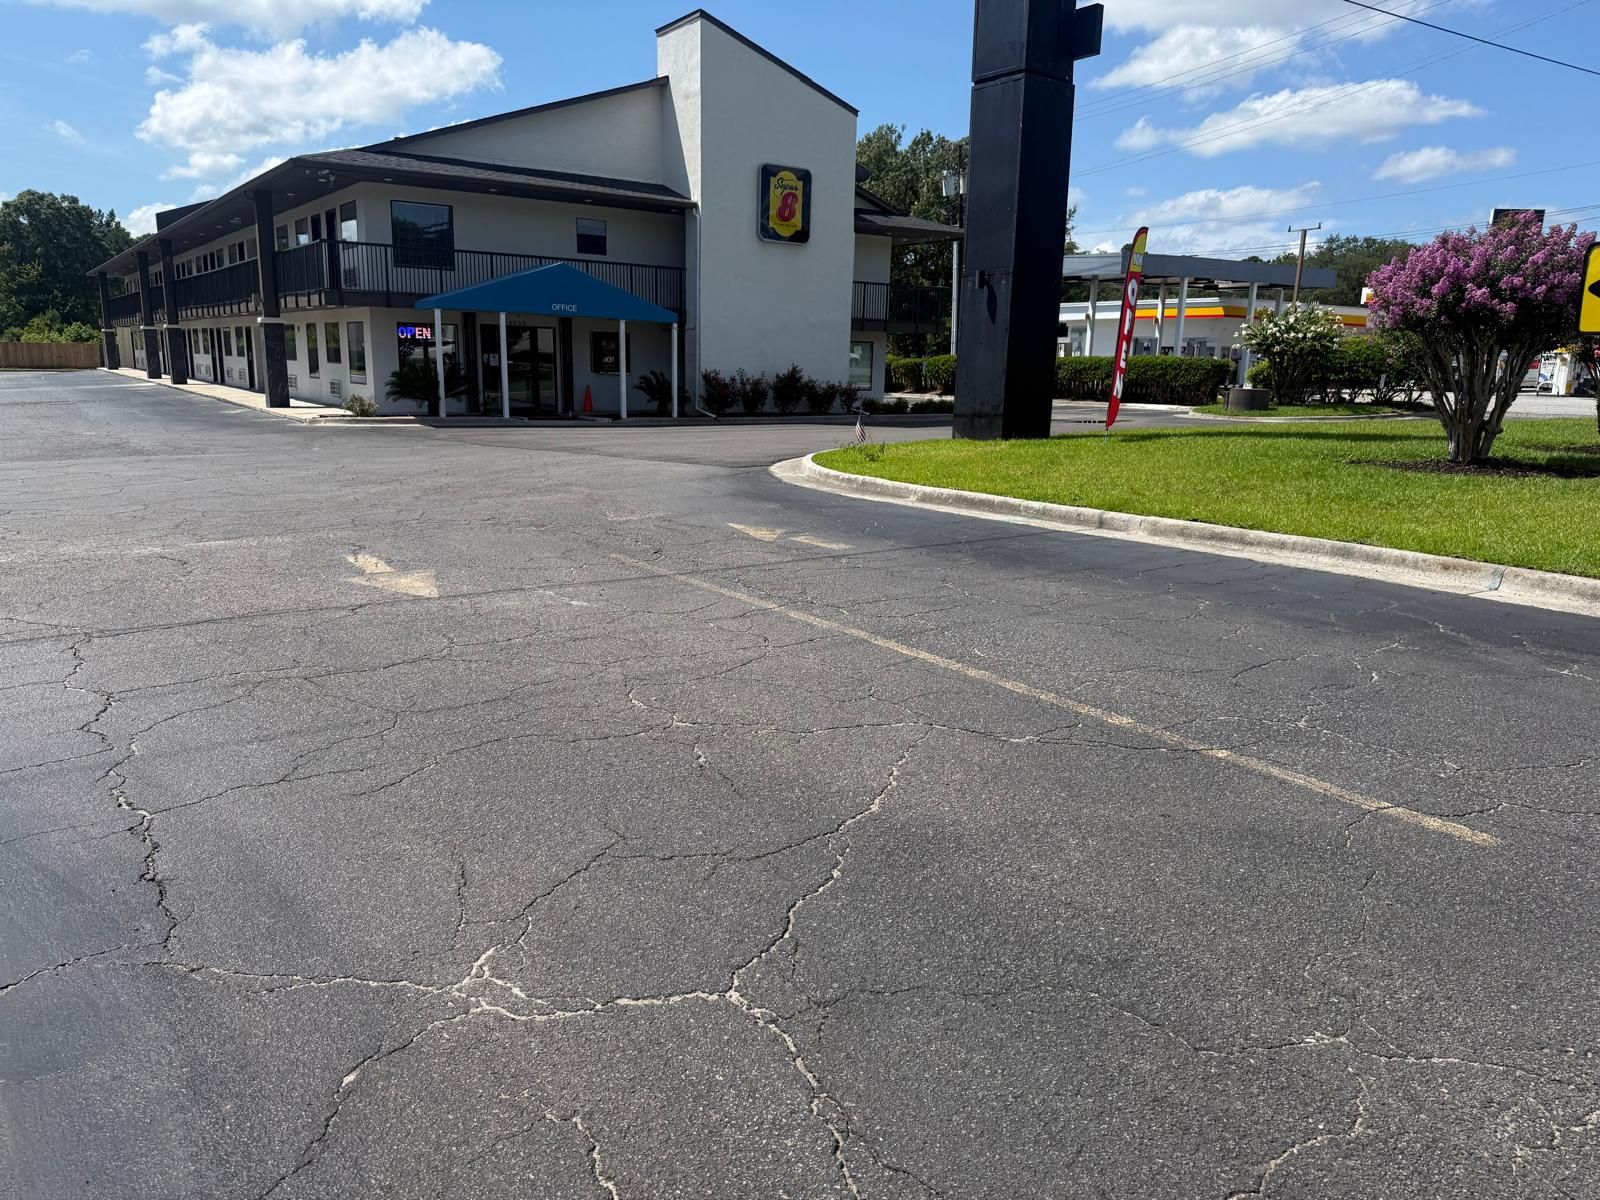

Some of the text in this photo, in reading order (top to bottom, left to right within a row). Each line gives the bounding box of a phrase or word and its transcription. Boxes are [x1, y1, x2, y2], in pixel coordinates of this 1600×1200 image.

[773, 177, 799, 197] Super
[776, 191, 799, 222] 8
[551, 303, 577, 312] OFFICE
[398, 326, 431, 339] OPEN
[1113, 278, 1138, 399] OPEN
